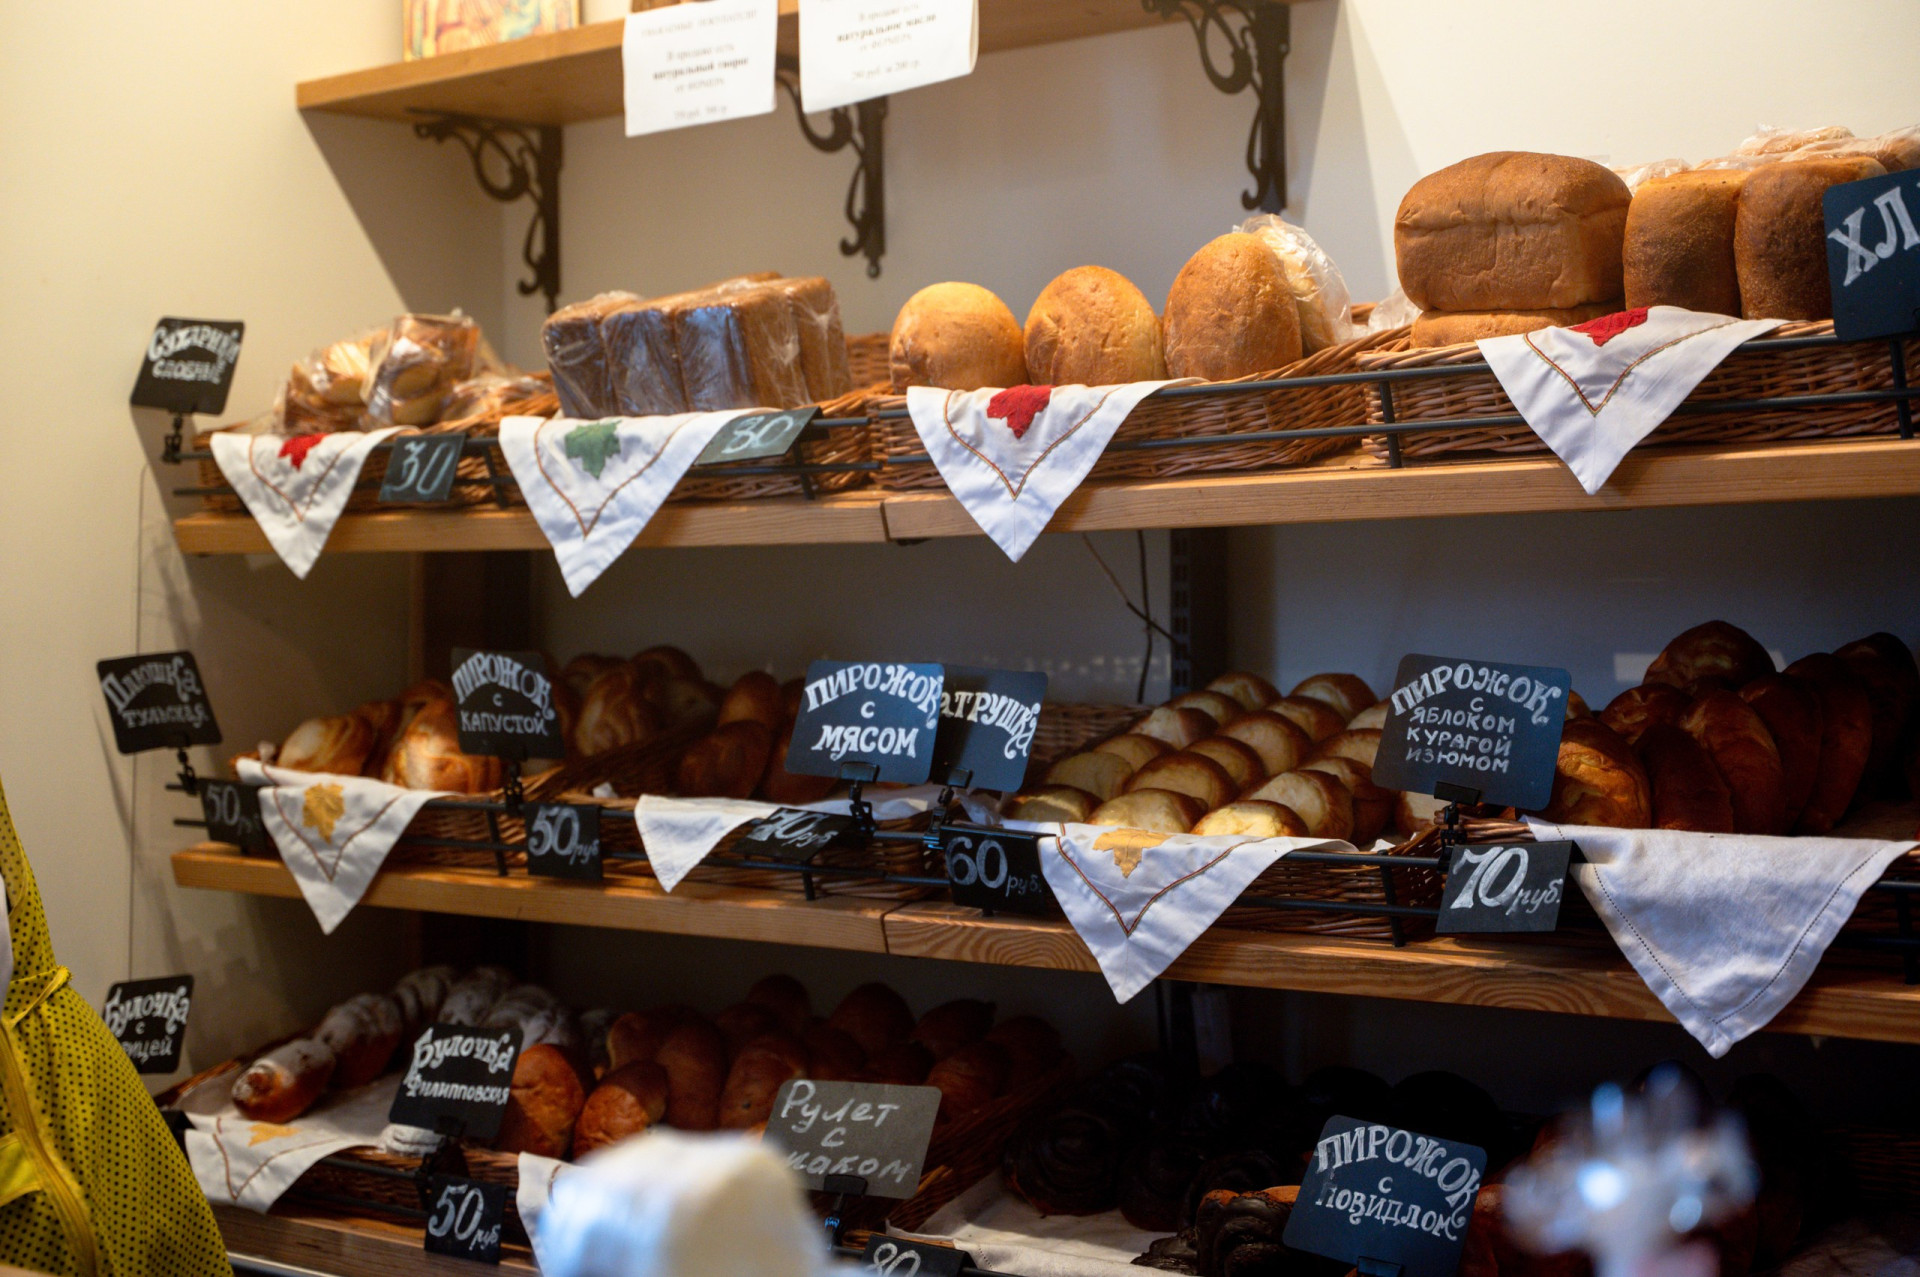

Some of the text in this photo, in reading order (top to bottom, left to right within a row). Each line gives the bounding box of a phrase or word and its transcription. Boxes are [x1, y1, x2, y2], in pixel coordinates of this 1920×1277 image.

[1827, 182, 1920, 287] ХЛ
[389, 441, 457, 495] 30
[451, 651, 556, 720] ПИРОЖОК
[804, 663, 944, 730] ПИРОЖОК
[1390, 663, 1562, 725] ПИРОЖОК
[460, 710, 549, 737] КАПУСТОЙ
[811, 725, 918, 761] МЯСОМ
[940, 691, 1041, 760] АТРУШКА
[1406, 727, 1512, 757] КУРАГОЙ
[1409, 706, 1515, 735] ЯБЛОКОМ
[1405, 747, 1510, 774] ИЗЮМОМ
[403, 1027, 514, 1085] Булочка
[780, 1080, 900, 1133] Рулет
[1315, 1125, 1480, 1230] ПИРОЖОК
